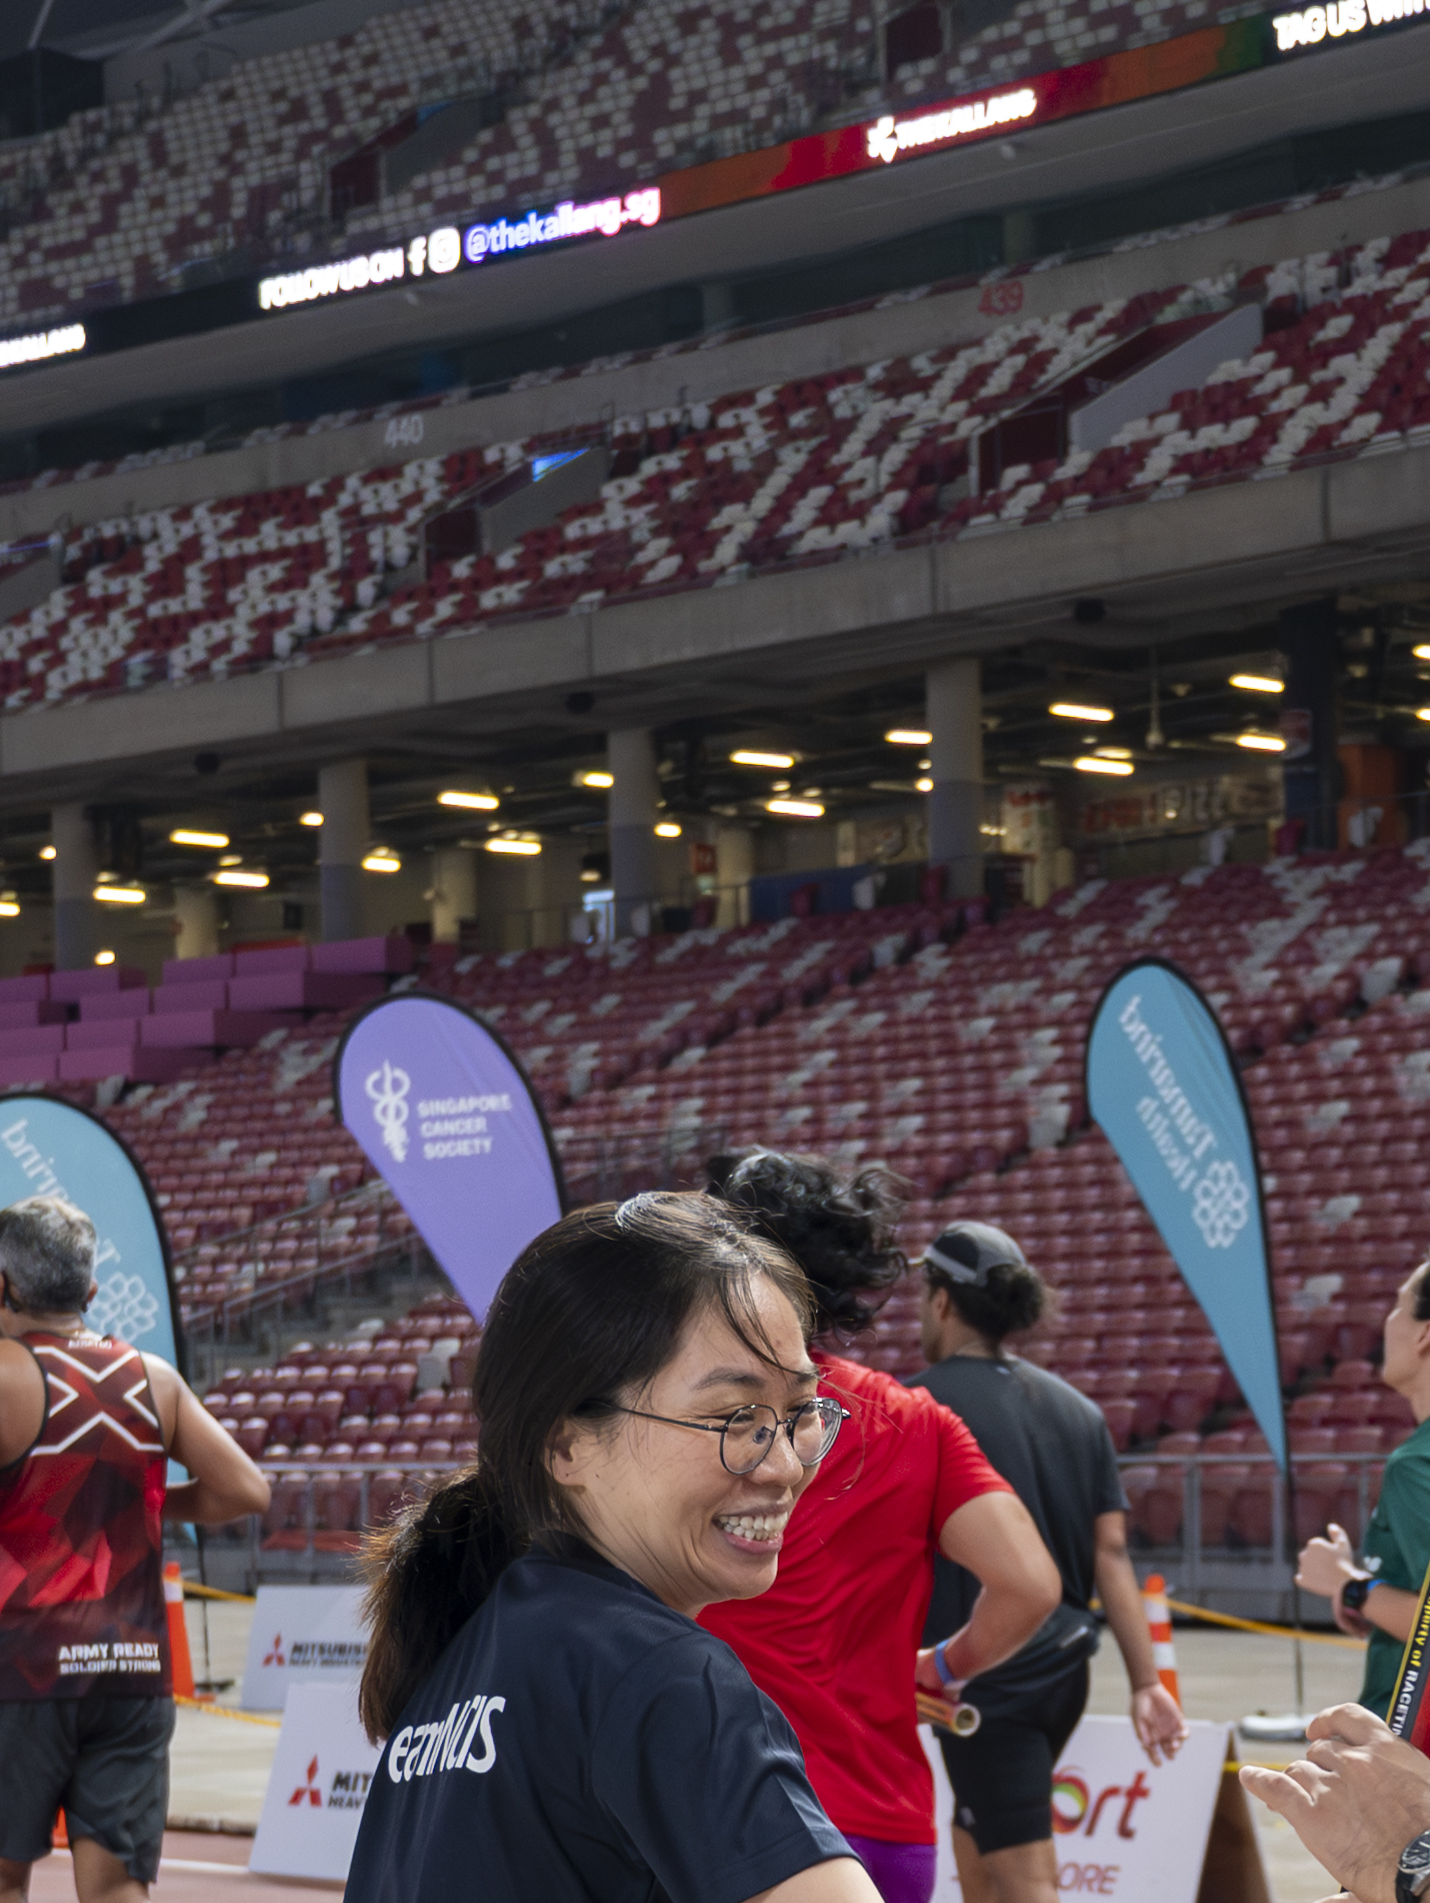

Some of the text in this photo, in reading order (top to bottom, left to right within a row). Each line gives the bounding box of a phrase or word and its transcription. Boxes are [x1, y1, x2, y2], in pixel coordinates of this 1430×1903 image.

[464, 186, 662, 264] @thekallang.sg
[976, 279, 1024, 316] 439
[383, 413, 425, 449] 440
[418, 1094, 512, 1119] SINGAPORE
[421, 1116, 487, 1138] CANCER
[423, 1137, 493, 1160] SOCIETY
[59, 1643, 159, 1661] ARMY READY
[290, 1642, 368, 1657] MITSUBIS
[1409, 1650, 1423, 1668] of
[388, 1694, 507, 1784] eamNCIS
